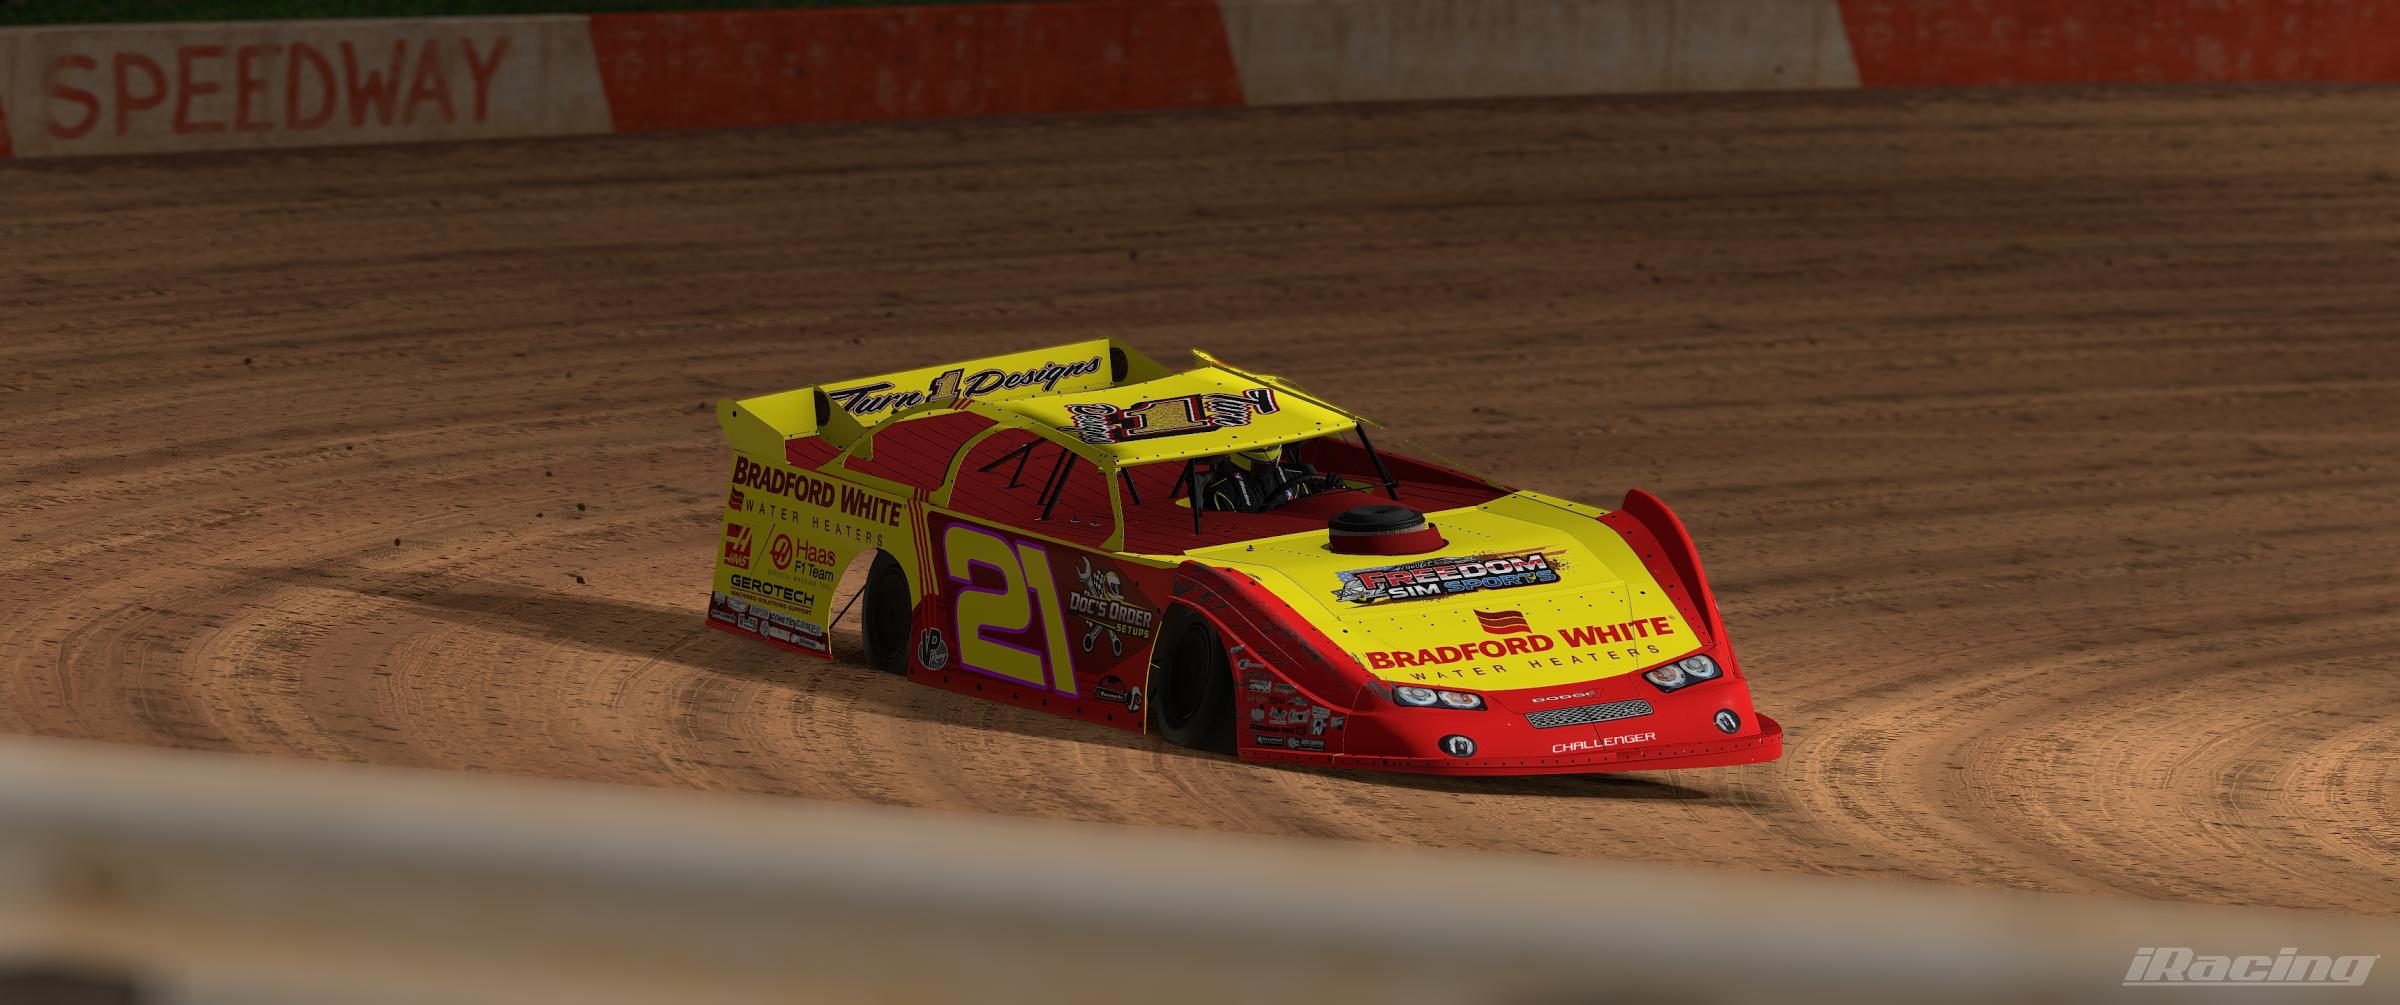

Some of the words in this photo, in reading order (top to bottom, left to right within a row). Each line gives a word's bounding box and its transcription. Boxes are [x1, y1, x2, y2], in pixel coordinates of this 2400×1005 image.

[44, 36, 510, 139] SPEEDWAY
[829, 383, 924, 416] Turn
[925, 368, 965, 402] 1
[962, 356, 1102, 398] Designs
[732, 455, 836, 508] BRADFORD
[840, 484, 903, 527] WHITE
[745, 499, 799, 523] WATER
[812, 516, 883, 547] HEATERS
[796, 538, 836, 567] Haas
[794, 560, 806, 575] F1
[808, 564, 834, 582] Team
[1358, 554, 1547, 589] FREEDOM
[1389, 583, 1441, 599] SIM
[1443, 570, 1557, 593] SPORTS
[731, 574, 815, 606] GEROTECH
[943, 523, 1079, 698] 21
[1069, 592, 1108, 617] DOC'S
[1109, 601, 1152, 629] ORDER
[1116, 623, 1150, 639] SETUPS
[1366, 634, 1554, 670] BRADFORD
[1558, 616, 1674, 648] WHITE
[1411, 664, 1506, 681] WATER
[1530, 644, 1660, 668] HEATERS
[1532, 691, 1597, 703] DODGE
[1552, 732, 1657, 753] CHALLENGER
